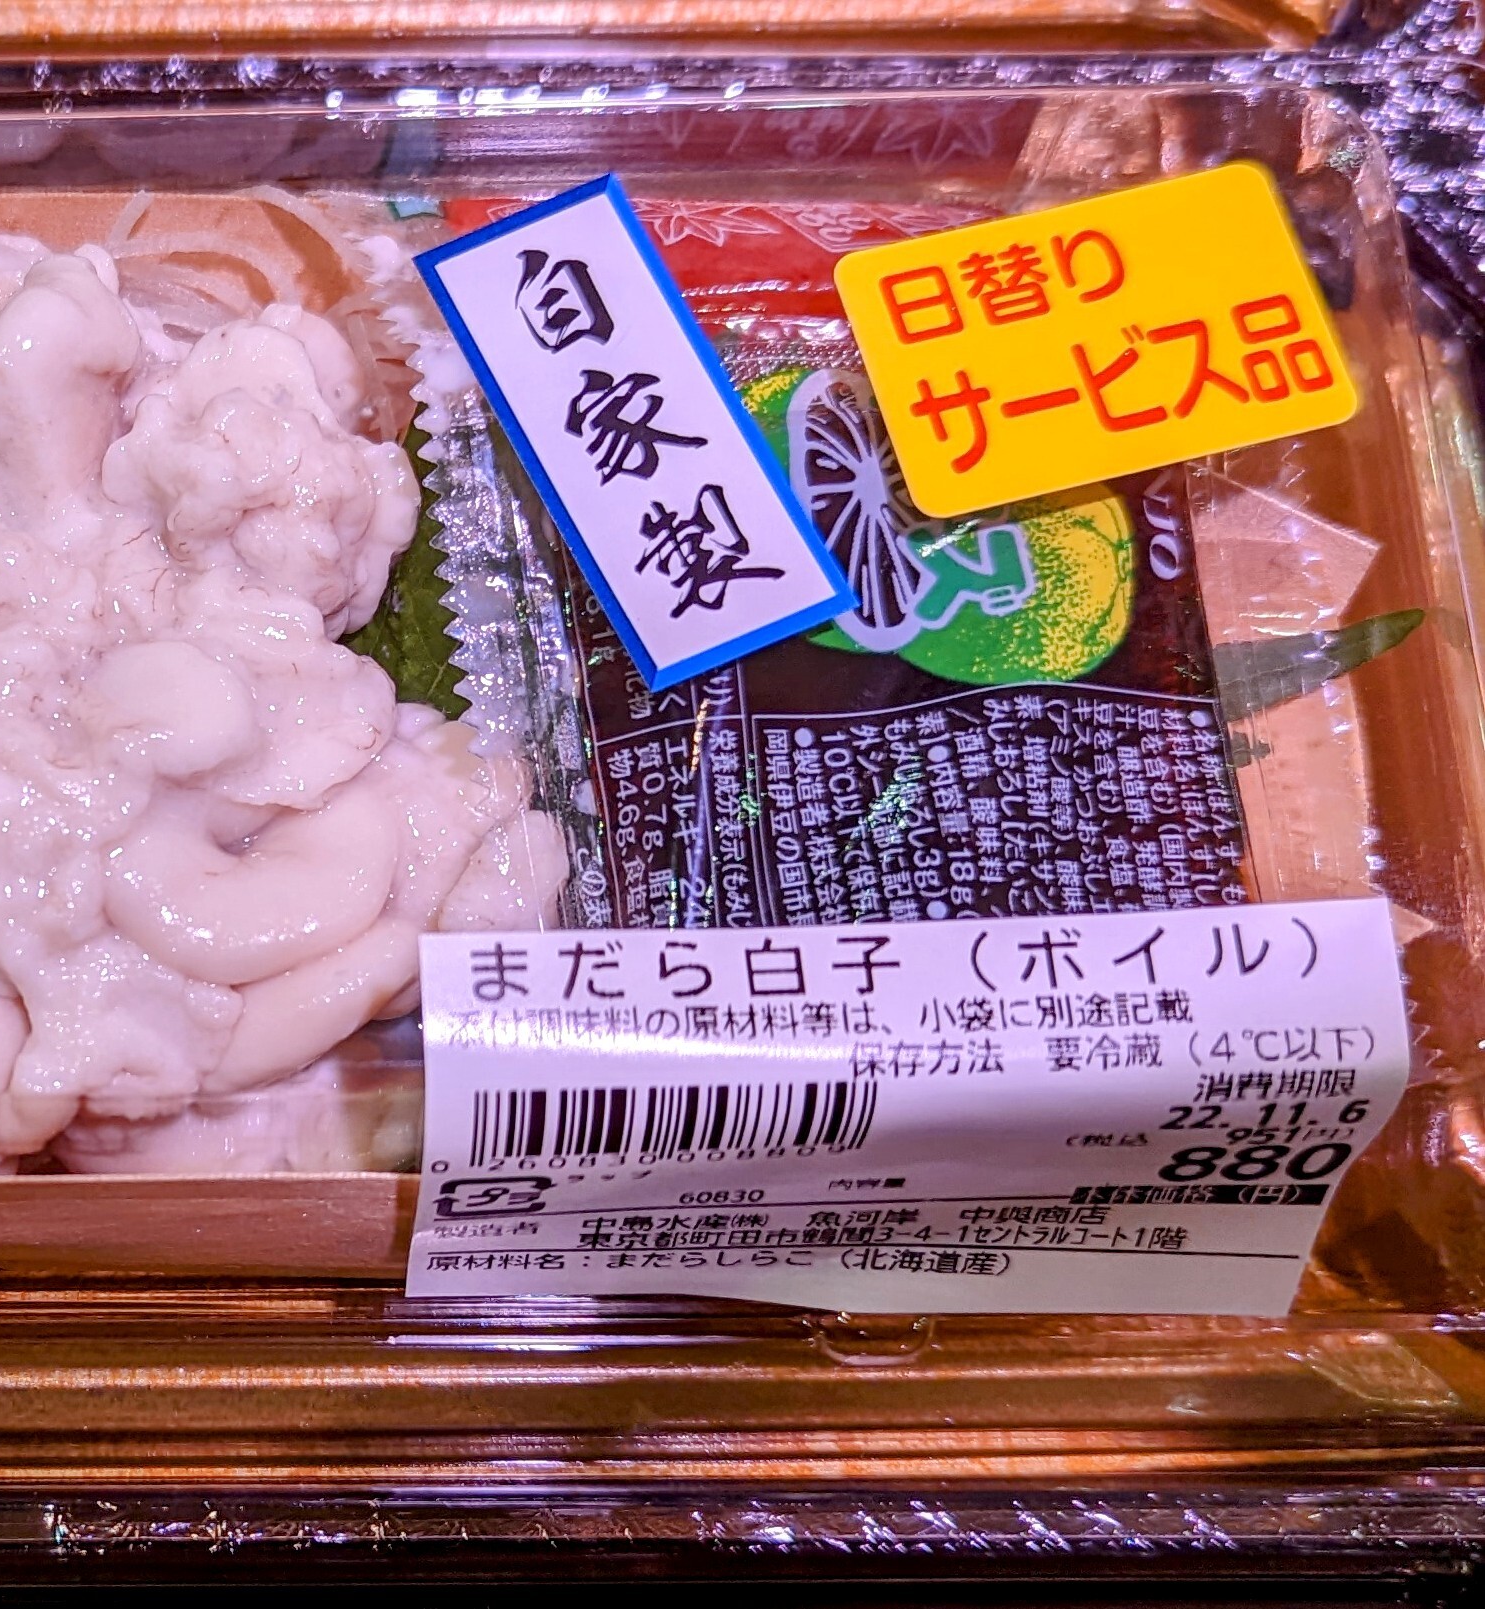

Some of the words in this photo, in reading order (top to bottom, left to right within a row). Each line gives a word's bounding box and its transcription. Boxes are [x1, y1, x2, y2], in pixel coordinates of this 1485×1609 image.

[879, 229, 1125, 345] 日替り
[911, 293, 1335, 474] サービス品
[515, 249, 786, 619] 自家製
[1194, 1068, 1357, 1102] 消費期限
[679, 1188, 764, 1204] 60830
[1158, 1142, 1353, 1182] 880
